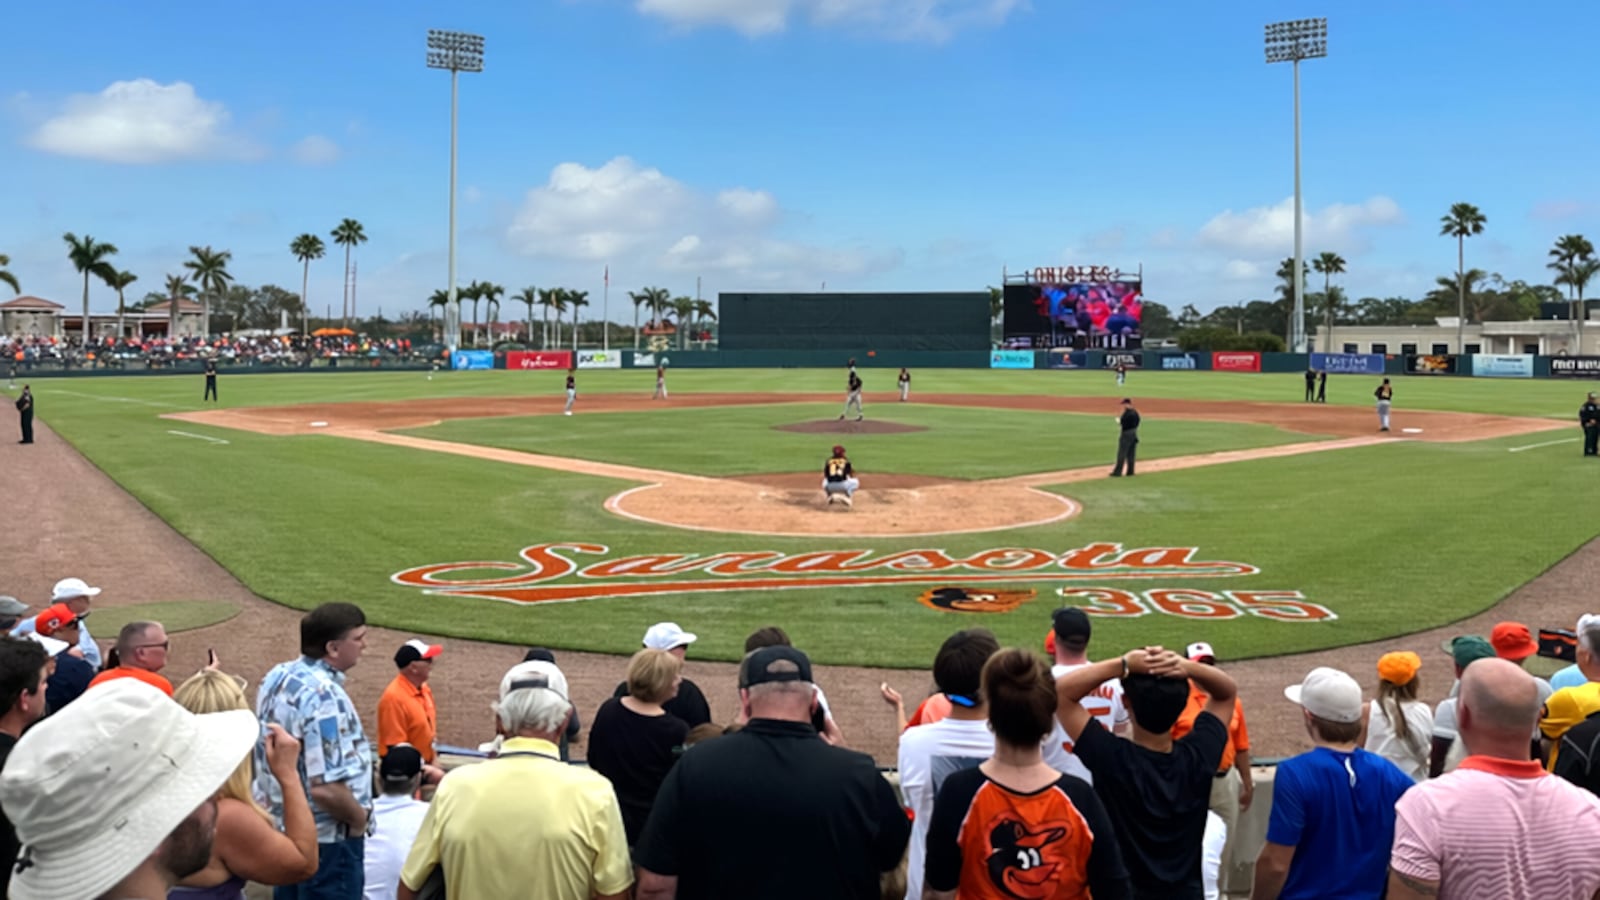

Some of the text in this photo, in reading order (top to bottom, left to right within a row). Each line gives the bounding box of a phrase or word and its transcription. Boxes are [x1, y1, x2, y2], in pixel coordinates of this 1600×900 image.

[1034, 266, 1110, 284] ORIOLES
[391, 542, 1260, 602] Sarasota
[1056, 587, 1338, 622] 365
